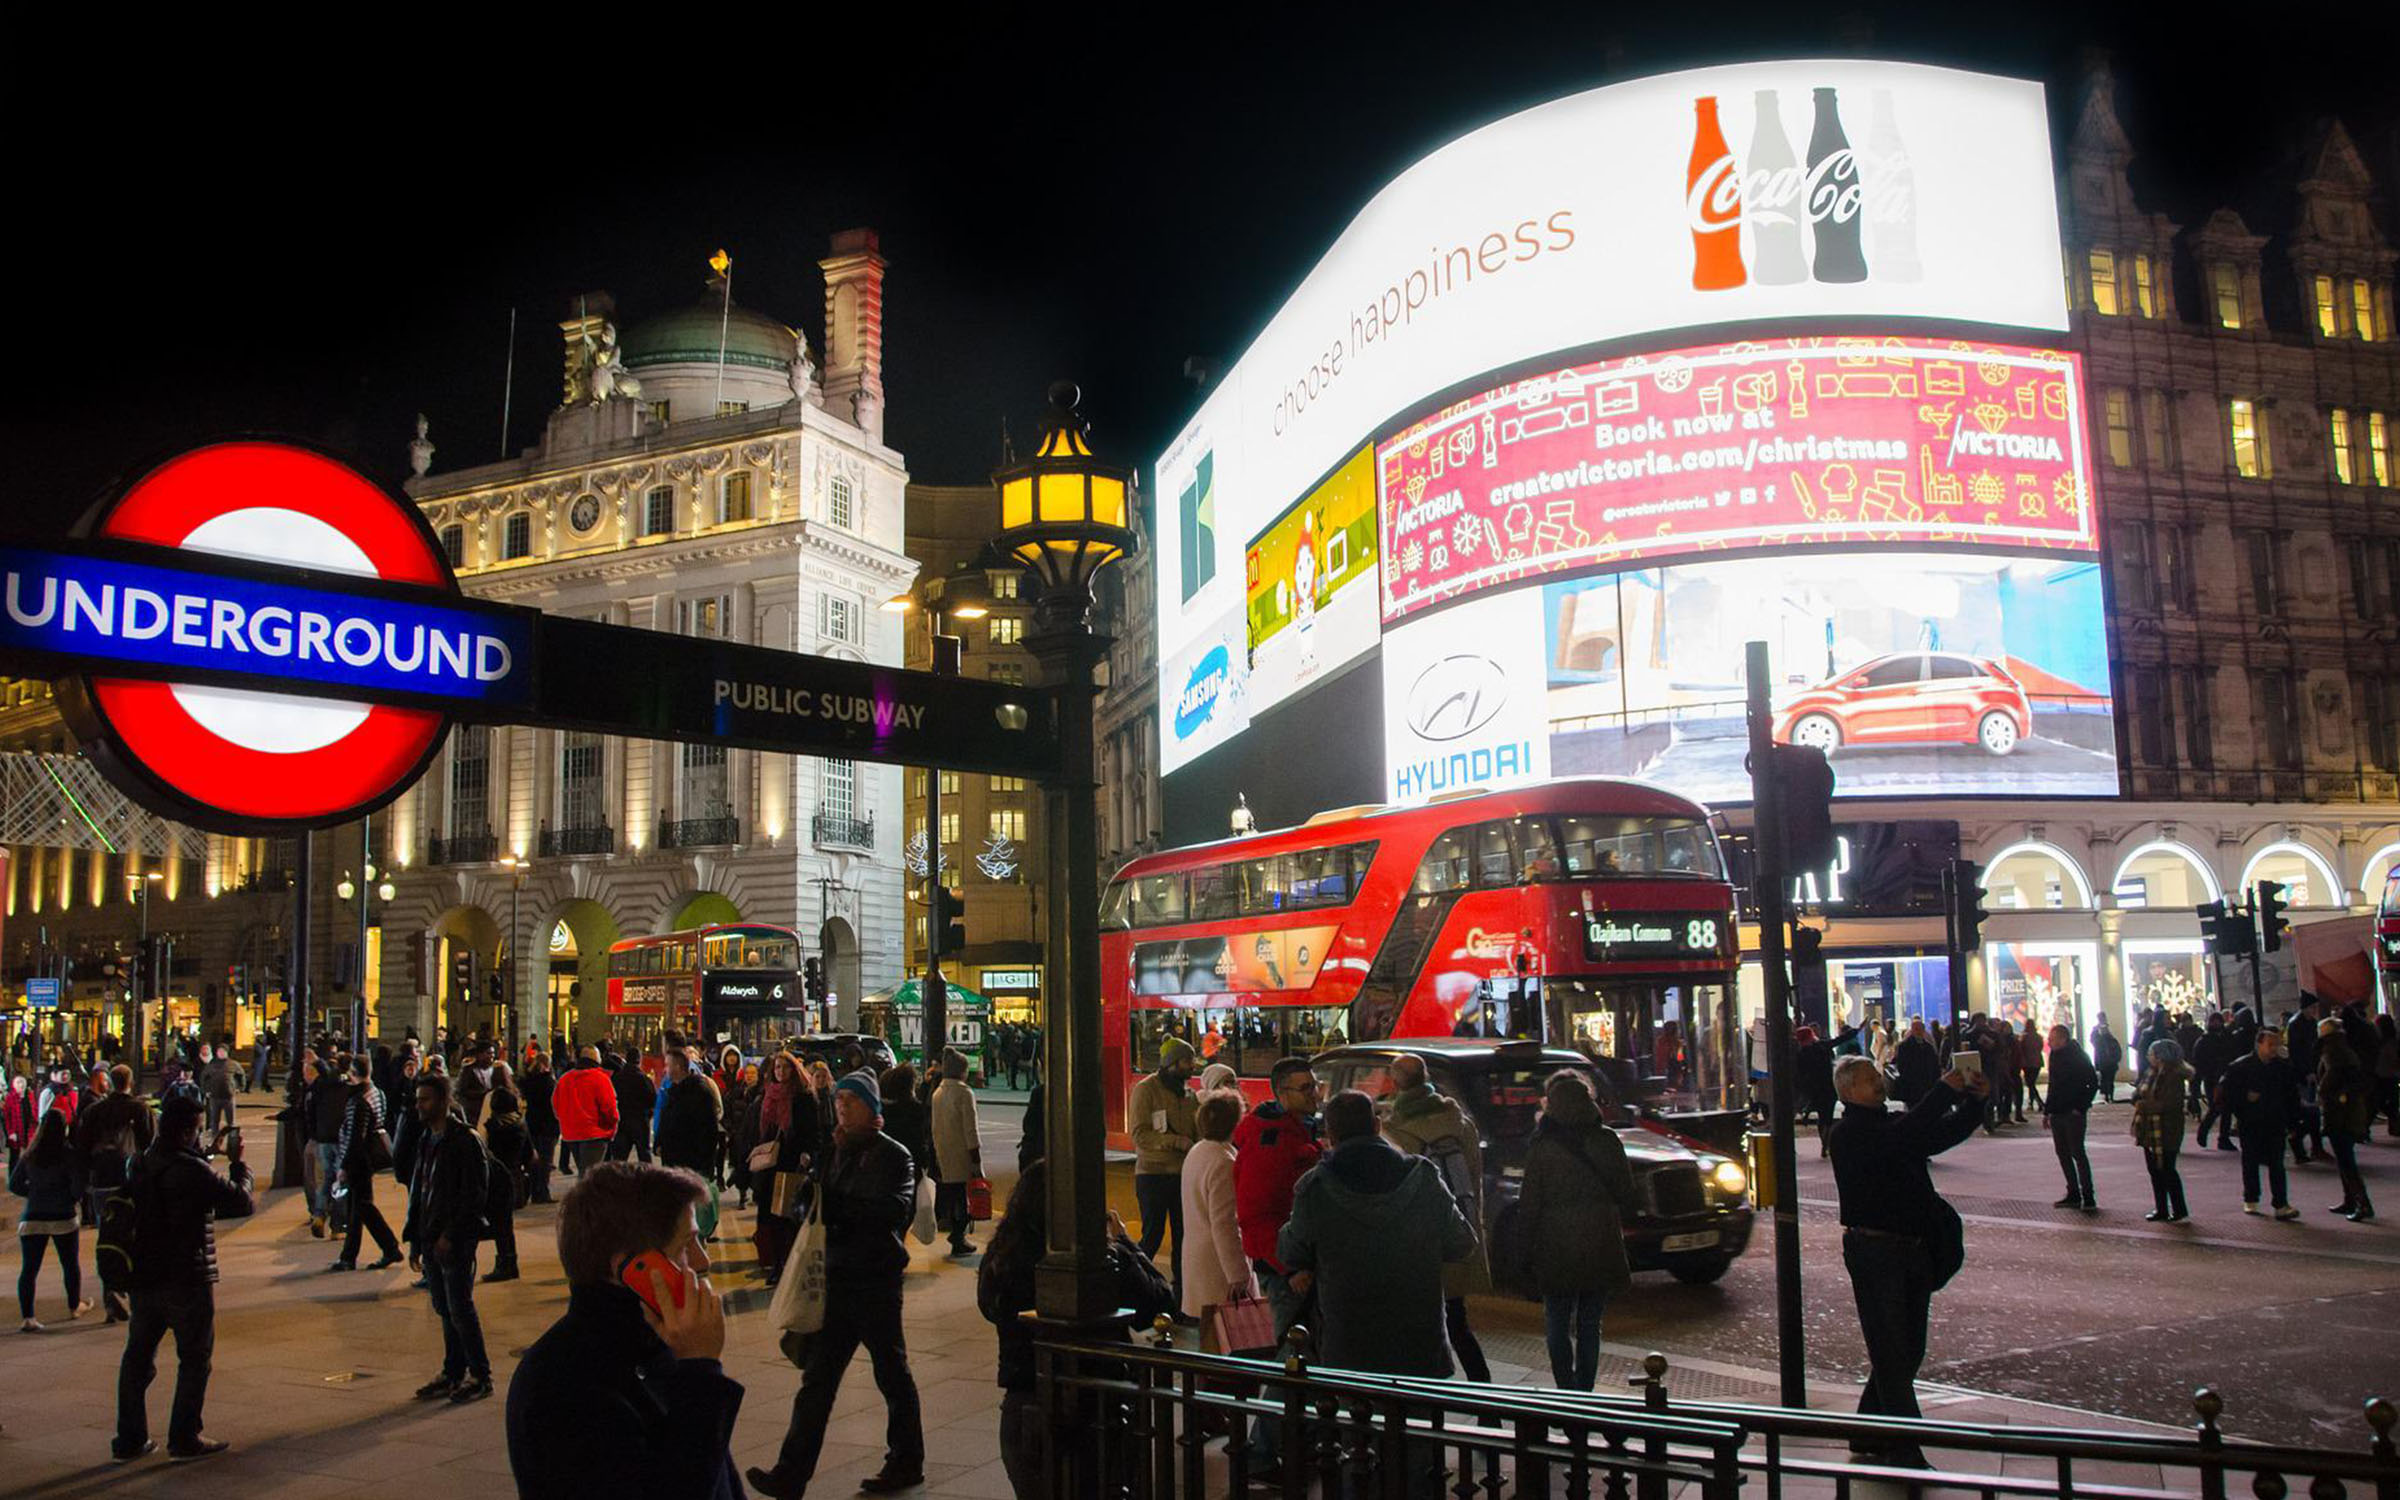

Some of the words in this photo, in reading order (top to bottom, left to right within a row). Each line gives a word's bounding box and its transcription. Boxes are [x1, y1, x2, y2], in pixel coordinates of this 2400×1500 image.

[1273, 336, 1344, 437] choose
[1350, 209, 1576, 358] happiness
[1595, 421, 1667, 449] Book
[1673, 412, 1735, 436] now
[1742, 406, 1775, 430] at
[1490, 436, 1909, 507] createvictoria.com/christmas
[5, 571, 512, 682] UNDERGROUND
[715, 679, 811, 717] PUBLIC
[820, 693, 925, 731] SUBWAY
[1396, 740, 1531, 799] HYUNDAI
[1589, 922, 1632, 947] Clapham
[1632, 923, 1672, 942] Common
[1688, 920, 1718, 949] 88
[720, 984, 758, 999] Aldwych
[772, 984, 783, 999] 6
[2000, 978, 2026, 993] PRIZE
